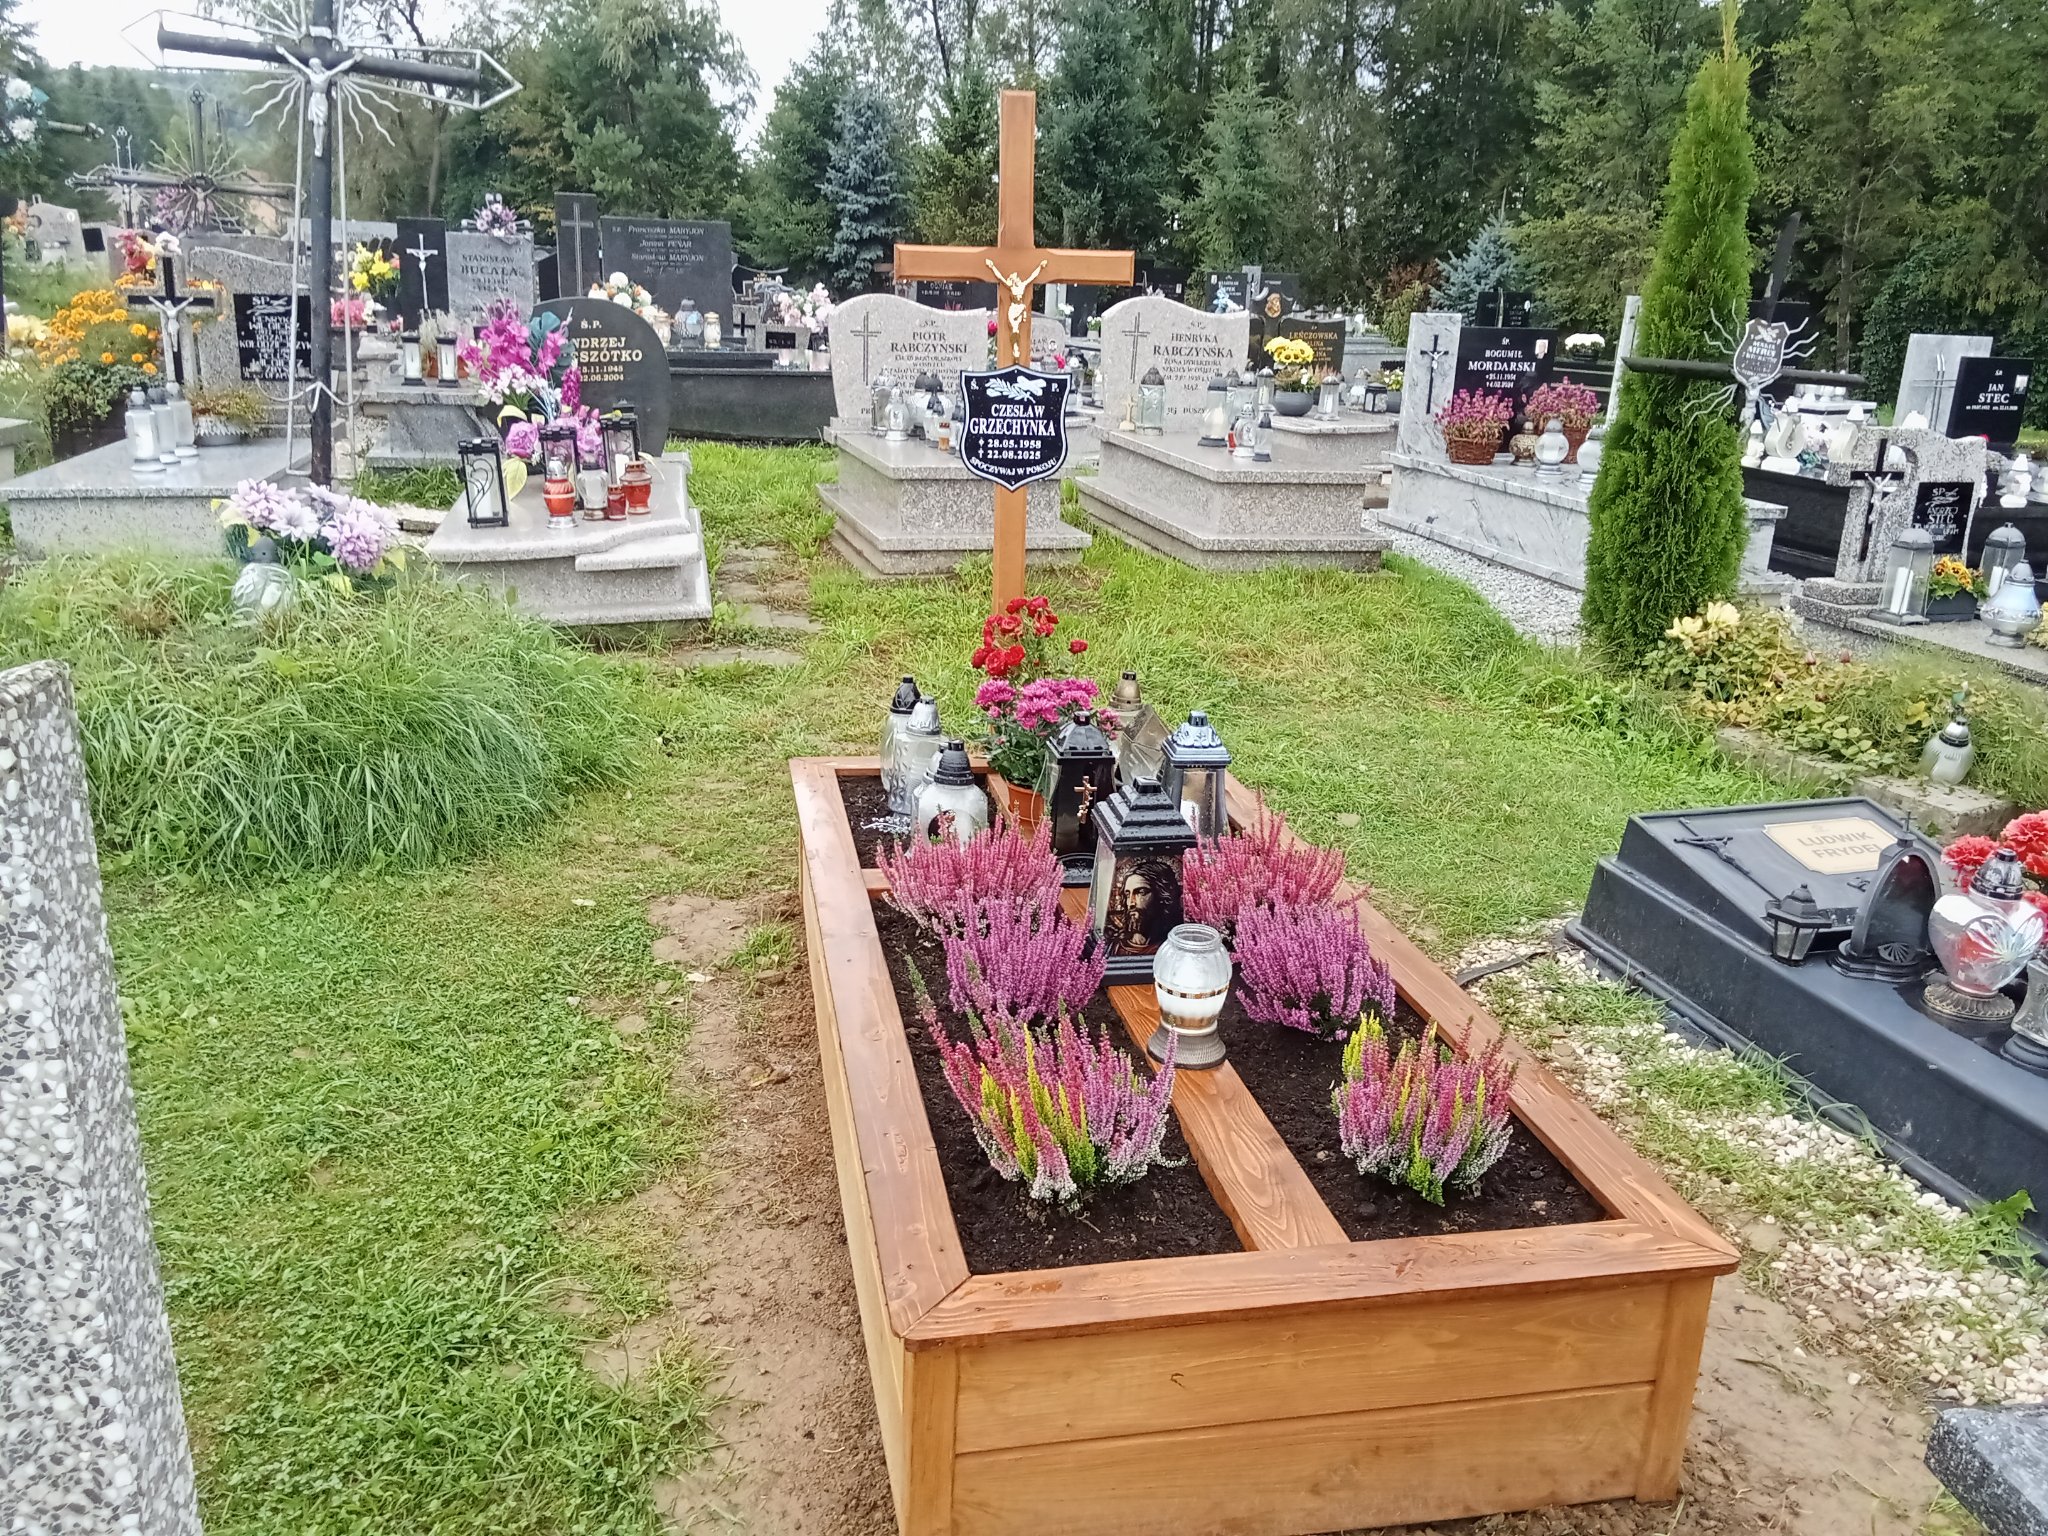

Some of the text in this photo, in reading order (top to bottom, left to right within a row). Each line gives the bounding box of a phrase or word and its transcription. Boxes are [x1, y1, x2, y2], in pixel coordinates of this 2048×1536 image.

[912, 331, 947, 342] PIOTR
[1171, 333, 1218, 344] HENRYKA
[571, 337, 626, 348] NDRZEJ
[1484, 349, 1523, 359] BOGUMIŁ
[1467, 360, 1536, 372] MORDARSKI
[1051, 382, 1060, 392] P.
[1987, 383, 2005, 392] JAN
[1977, 392, 2010, 404] STEC
[969, 417, 1056, 437] GRZECHYNKA
[987, 438, 1042, 449] 28.05.1958
[986, 449, 1041, 460] 22.08.2025
[969, 456, 1057, 476] SPOCZYWAJ W POKOJU
[1797, 831, 1876, 847] LUDWIK
